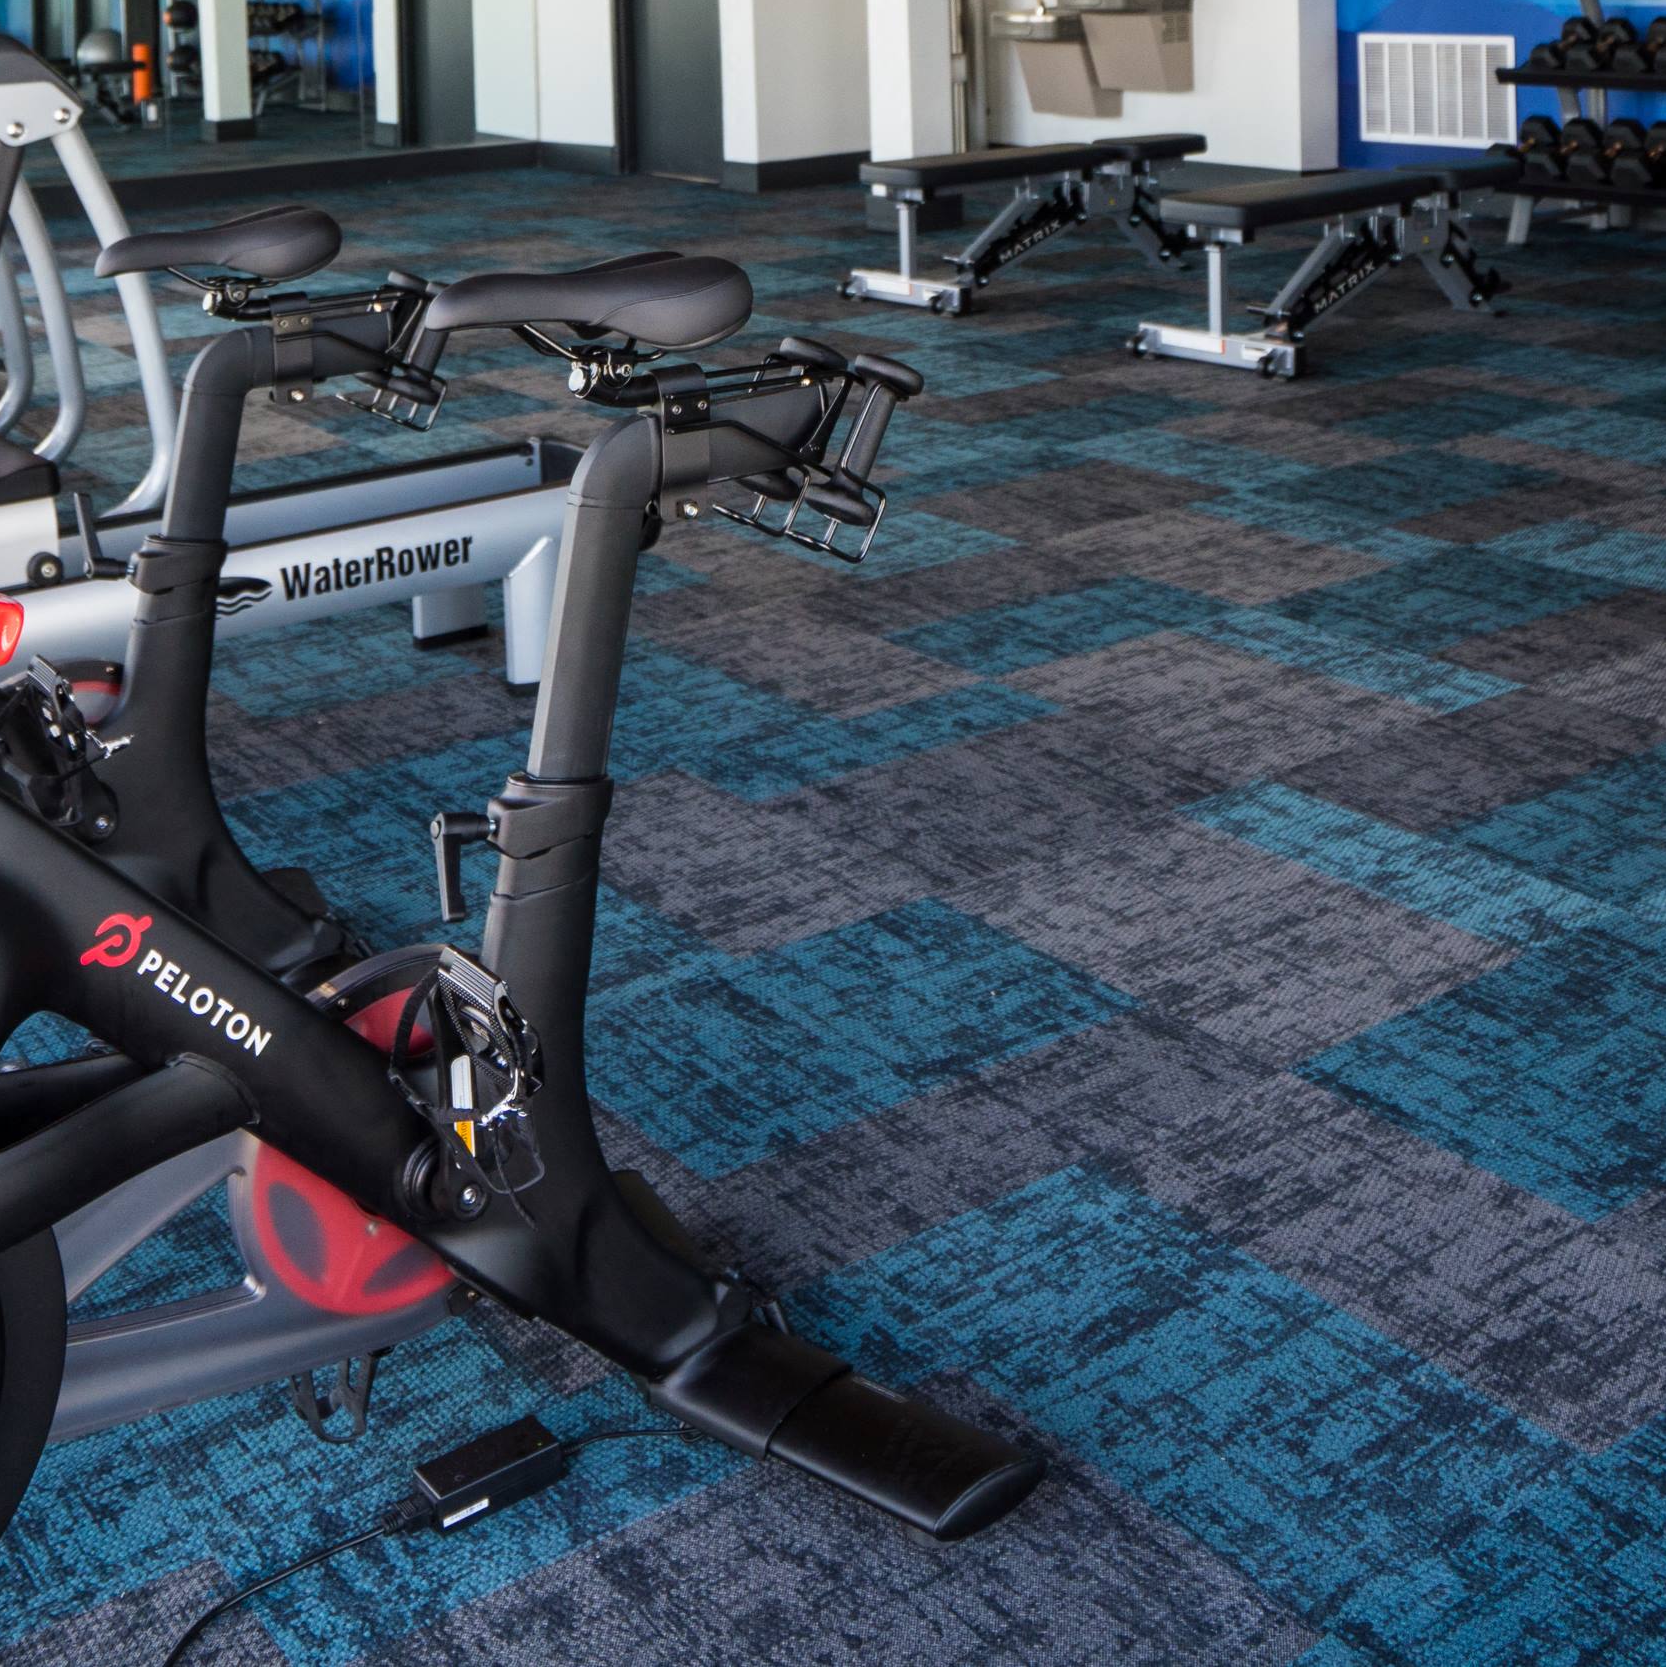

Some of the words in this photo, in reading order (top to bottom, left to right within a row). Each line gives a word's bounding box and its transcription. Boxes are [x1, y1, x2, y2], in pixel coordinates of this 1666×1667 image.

[998, 220, 1061, 263] MATRIX
[1314, 260, 1375, 313] MATRIX
[281, 536, 473, 601] WaterRower
[137, 949, 272, 1056] PELOTON
